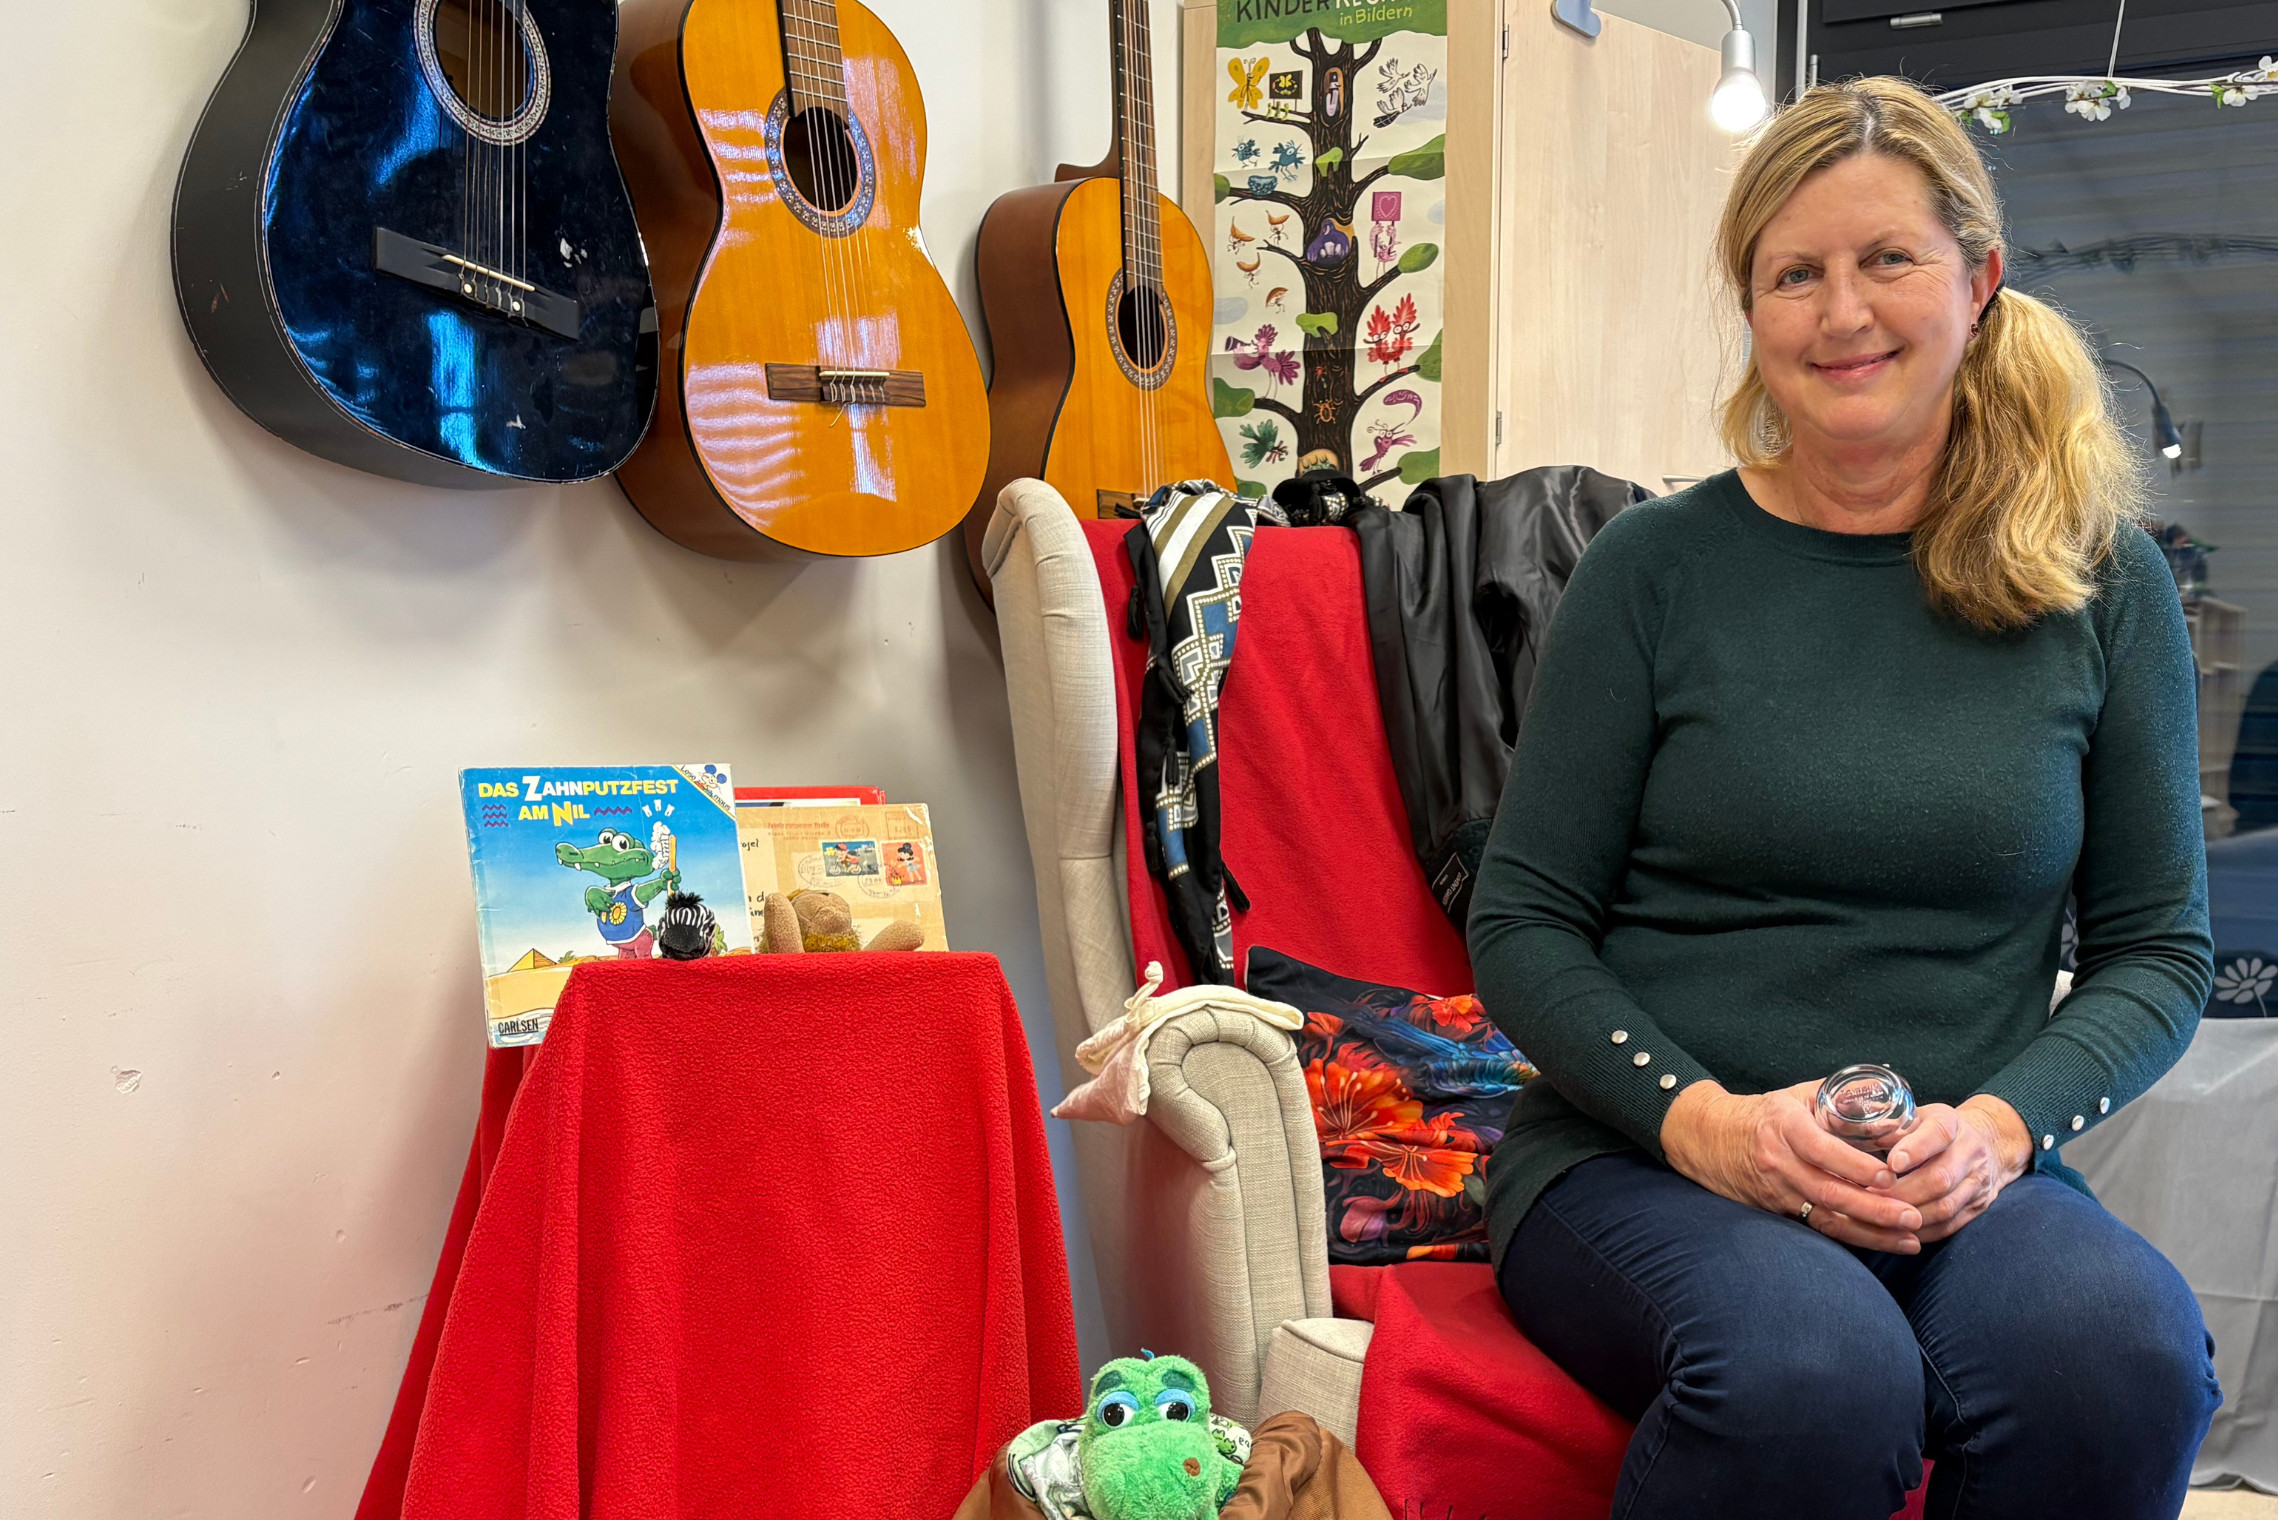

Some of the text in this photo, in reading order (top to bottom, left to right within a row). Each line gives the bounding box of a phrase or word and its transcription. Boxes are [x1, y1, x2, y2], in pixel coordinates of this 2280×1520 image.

[1339, 5, 1413, 26] in Bildern
[478, 782, 519, 798] DAS
[518, 804, 549, 821] AM
[741, 838, 759, 852] ogel
[497, 1018, 539, 1035] CARLSEN
